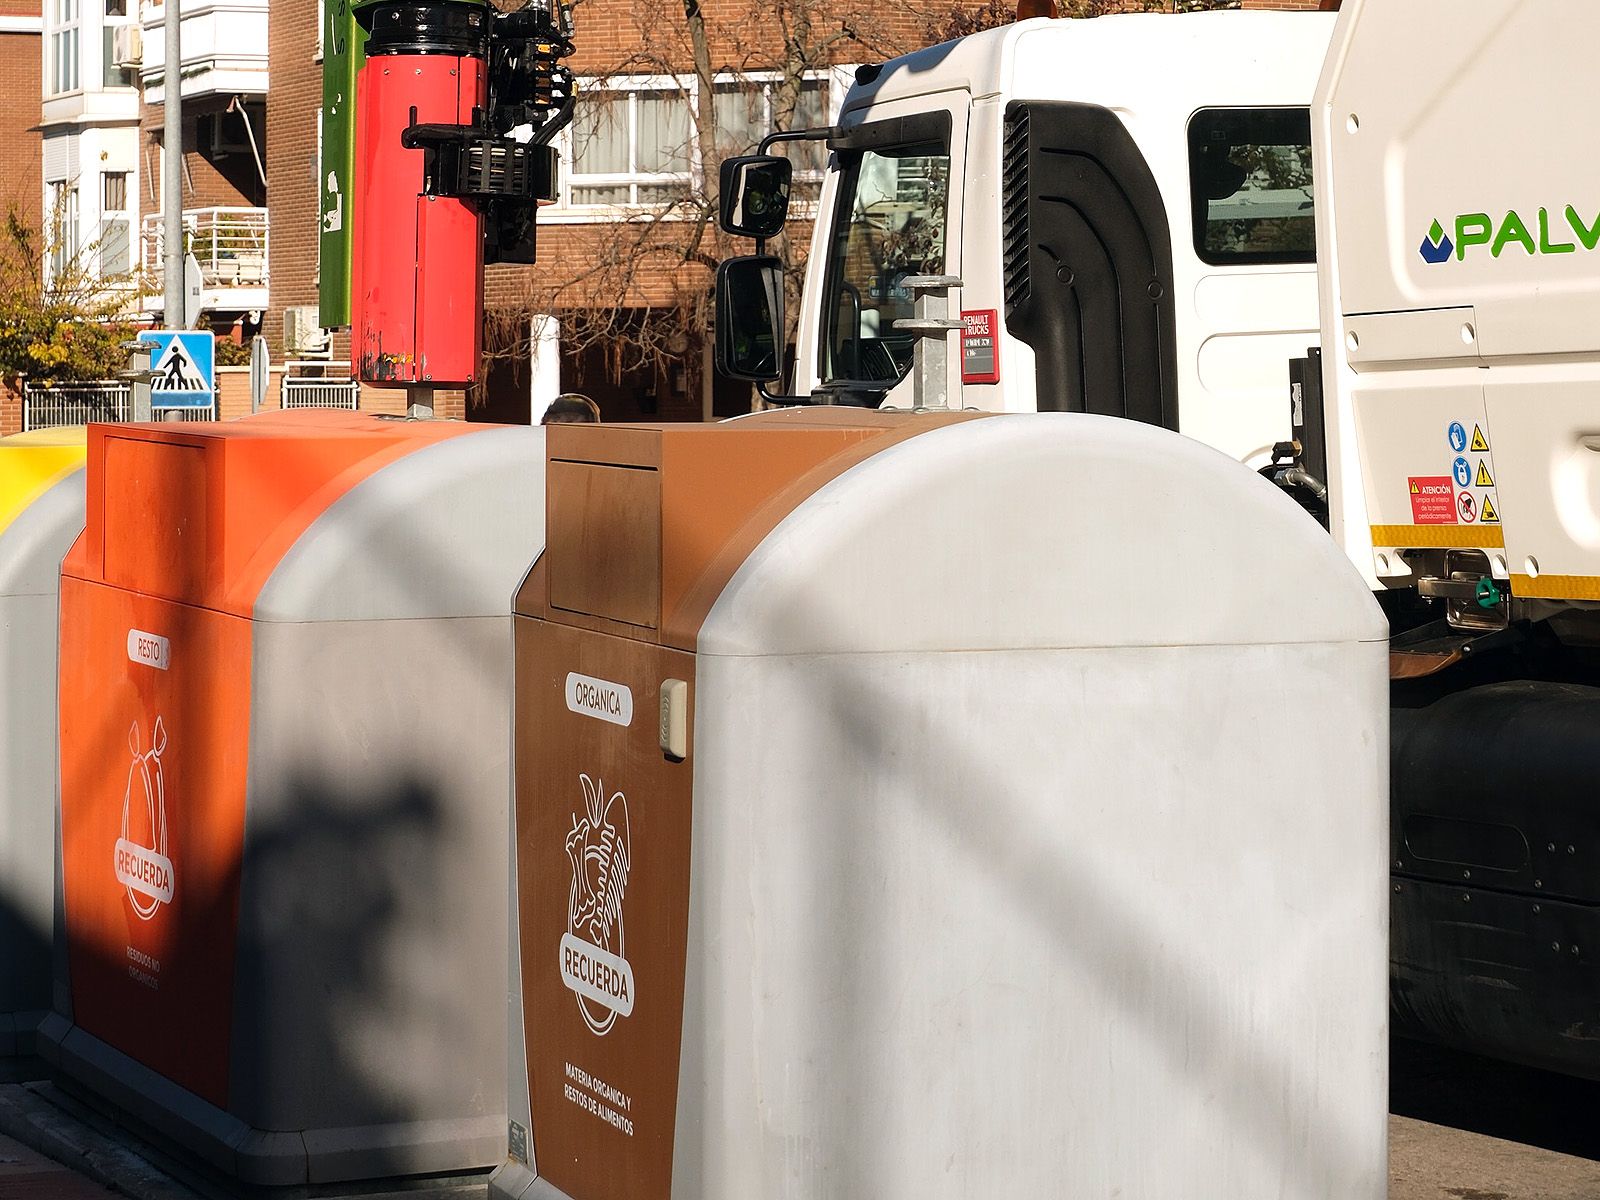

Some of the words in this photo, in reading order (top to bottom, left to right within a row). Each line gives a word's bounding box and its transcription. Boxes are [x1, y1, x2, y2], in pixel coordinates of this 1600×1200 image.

[1455, 203, 1600, 262] PALV
[963, 314, 989, 325] RENAULT
[965, 325, 989, 335] TRUCKS
[1422, 484, 1451, 494] ATENCIÓN
[138, 638, 160, 661] RESTO
[575, 682, 622, 716] ORGANICA
[118, 849, 170, 894] RECUERDA
[126, 945, 151, 968] RESIDUOS
[152, 958, 161, 973] NO
[565, 946, 629, 1003] RECUERDA
[128, 965, 160, 991] ORGANICOS
[565, 1061, 593, 1089] MATERIA
[592, 1077, 626, 1108] ORGANICA
[626, 1097, 632, 1112] Y
[564, 1083, 588, 1110] RESTOS
[588, 1098, 597, 1115] DE
[597, 1103, 634, 1137] ALIMENTOS
